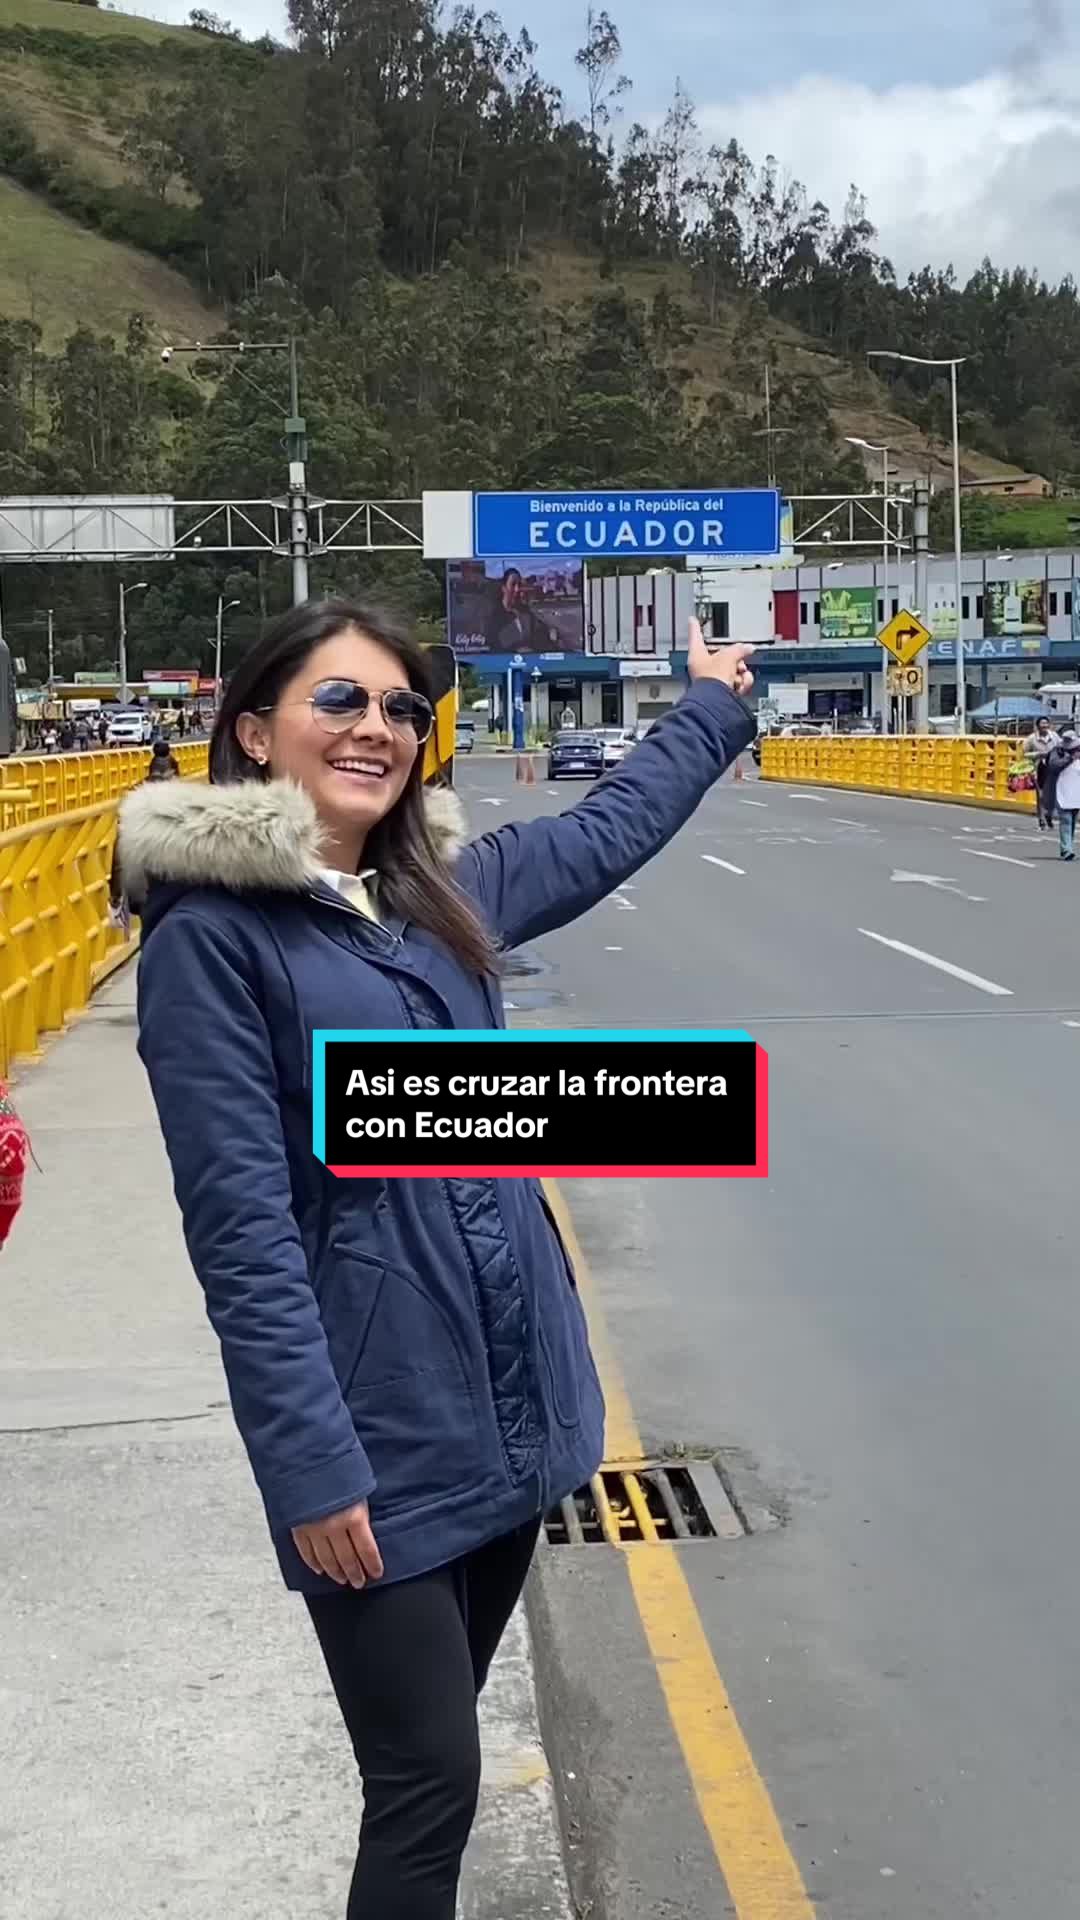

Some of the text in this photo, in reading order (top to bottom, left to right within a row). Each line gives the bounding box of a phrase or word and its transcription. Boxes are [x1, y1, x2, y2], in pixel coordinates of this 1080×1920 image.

[530, 498, 723, 515] Bienvenido a la República del
[529, 519, 724, 549] ECUADOR
